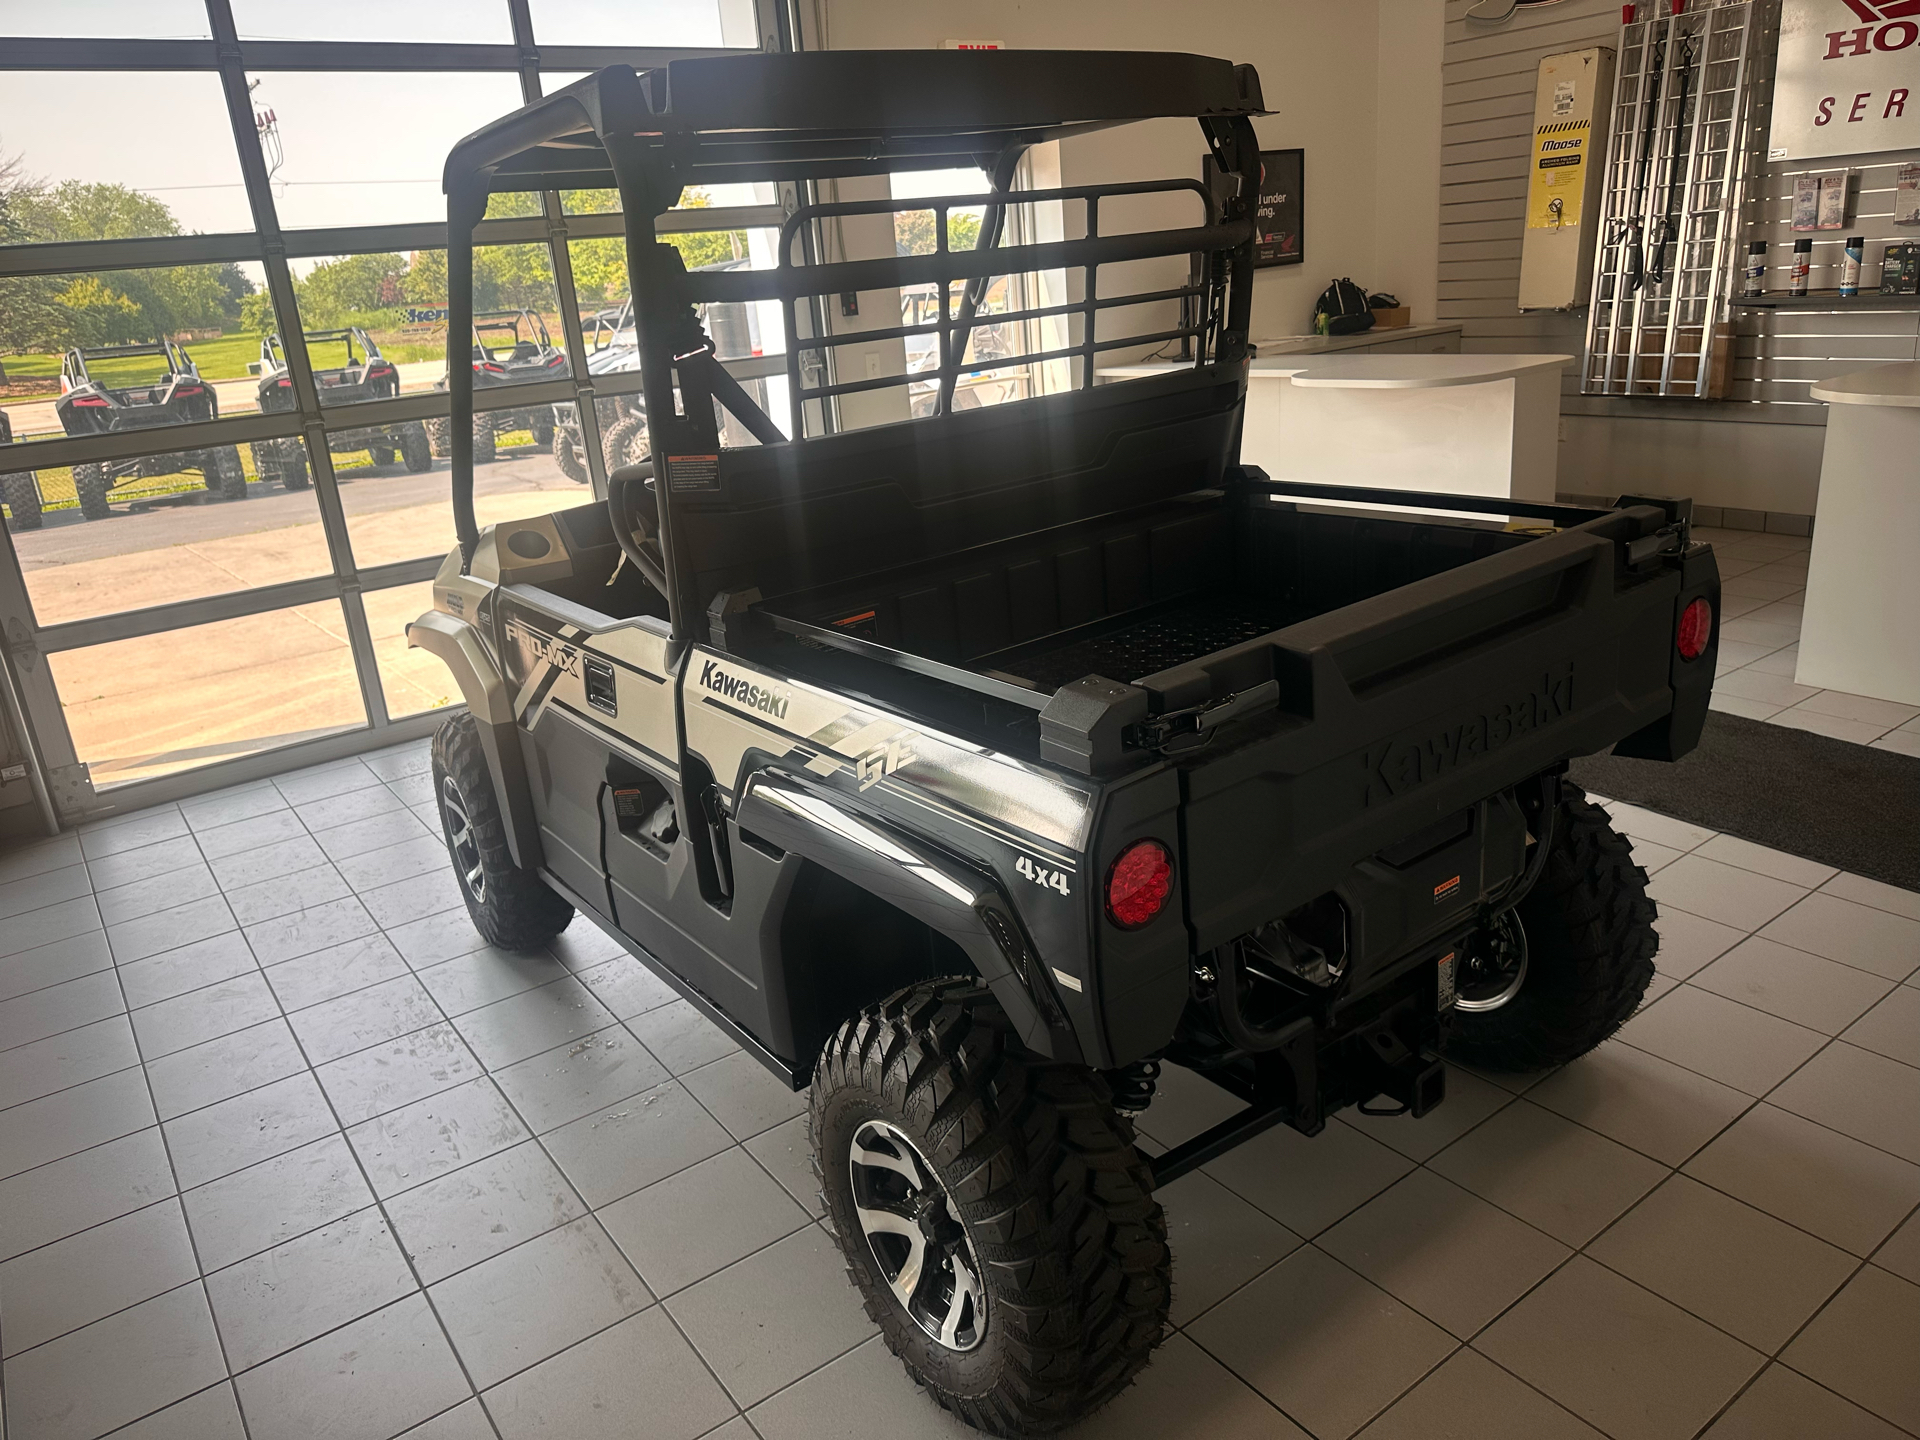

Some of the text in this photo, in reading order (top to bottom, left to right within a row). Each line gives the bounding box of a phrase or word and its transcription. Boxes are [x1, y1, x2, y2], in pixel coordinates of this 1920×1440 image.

[1822, 20, 1920, 61] HO
[1814, 88, 1909, 127] SER
[1541, 138, 1582, 151] Moose
[1263, 192, 1286, 205] under
[505, 623, 579, 679] PRO-MX
[699, 659, 792, 720] Kawasaki
[1360, 660, 1575, 808] Kawasaki
[1015, 855, 1071, 896] 4x4
